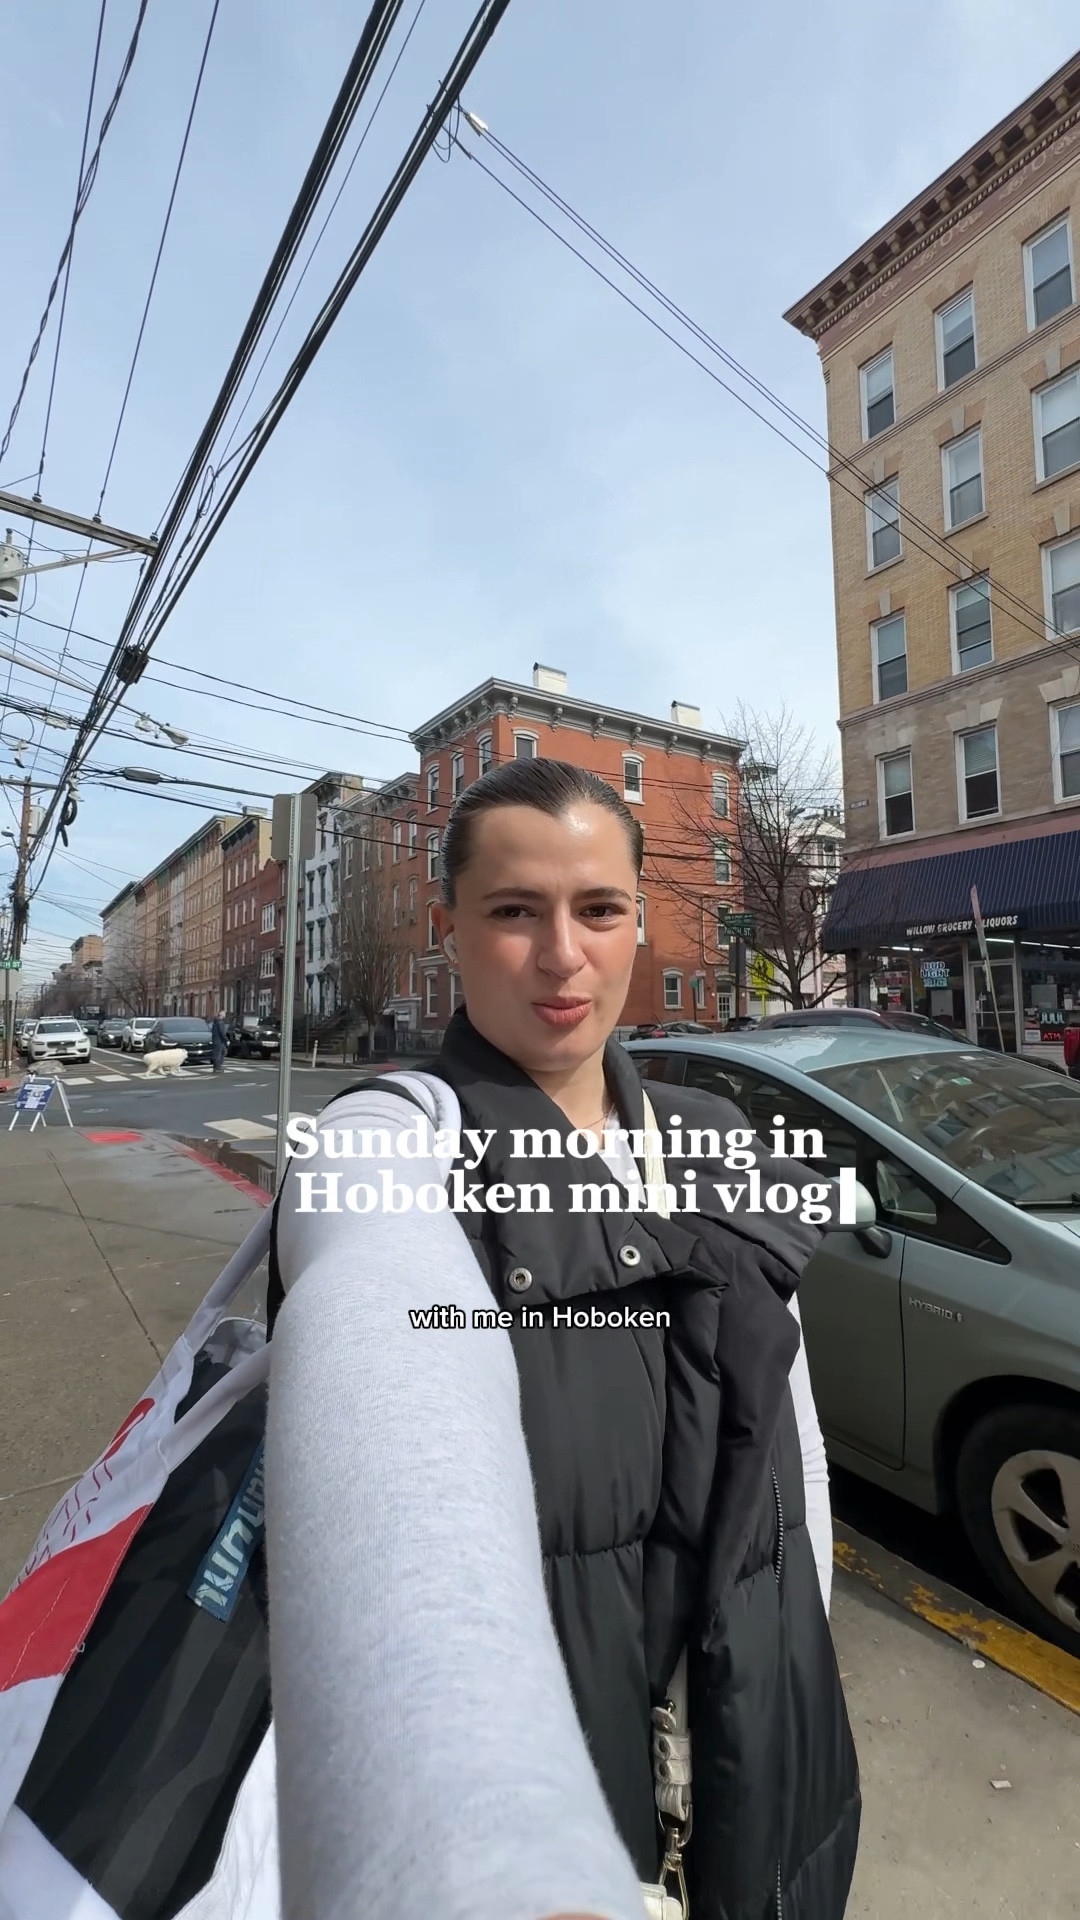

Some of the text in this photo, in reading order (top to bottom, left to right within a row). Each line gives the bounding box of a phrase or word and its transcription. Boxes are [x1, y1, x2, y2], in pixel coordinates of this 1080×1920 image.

[906, 924, 936, 936] WILLOW
[937, 920, 973, 933] GROCERY
[983, 915, 1018, 928] LIQUORS
[920, 969, 950, 978] LIGHT
[1040, 1012, 1064, 1024] JUUL
[1043, 1032, 1061, 1040] ATM
[909, 1297, 953, 1320] HYBRID
